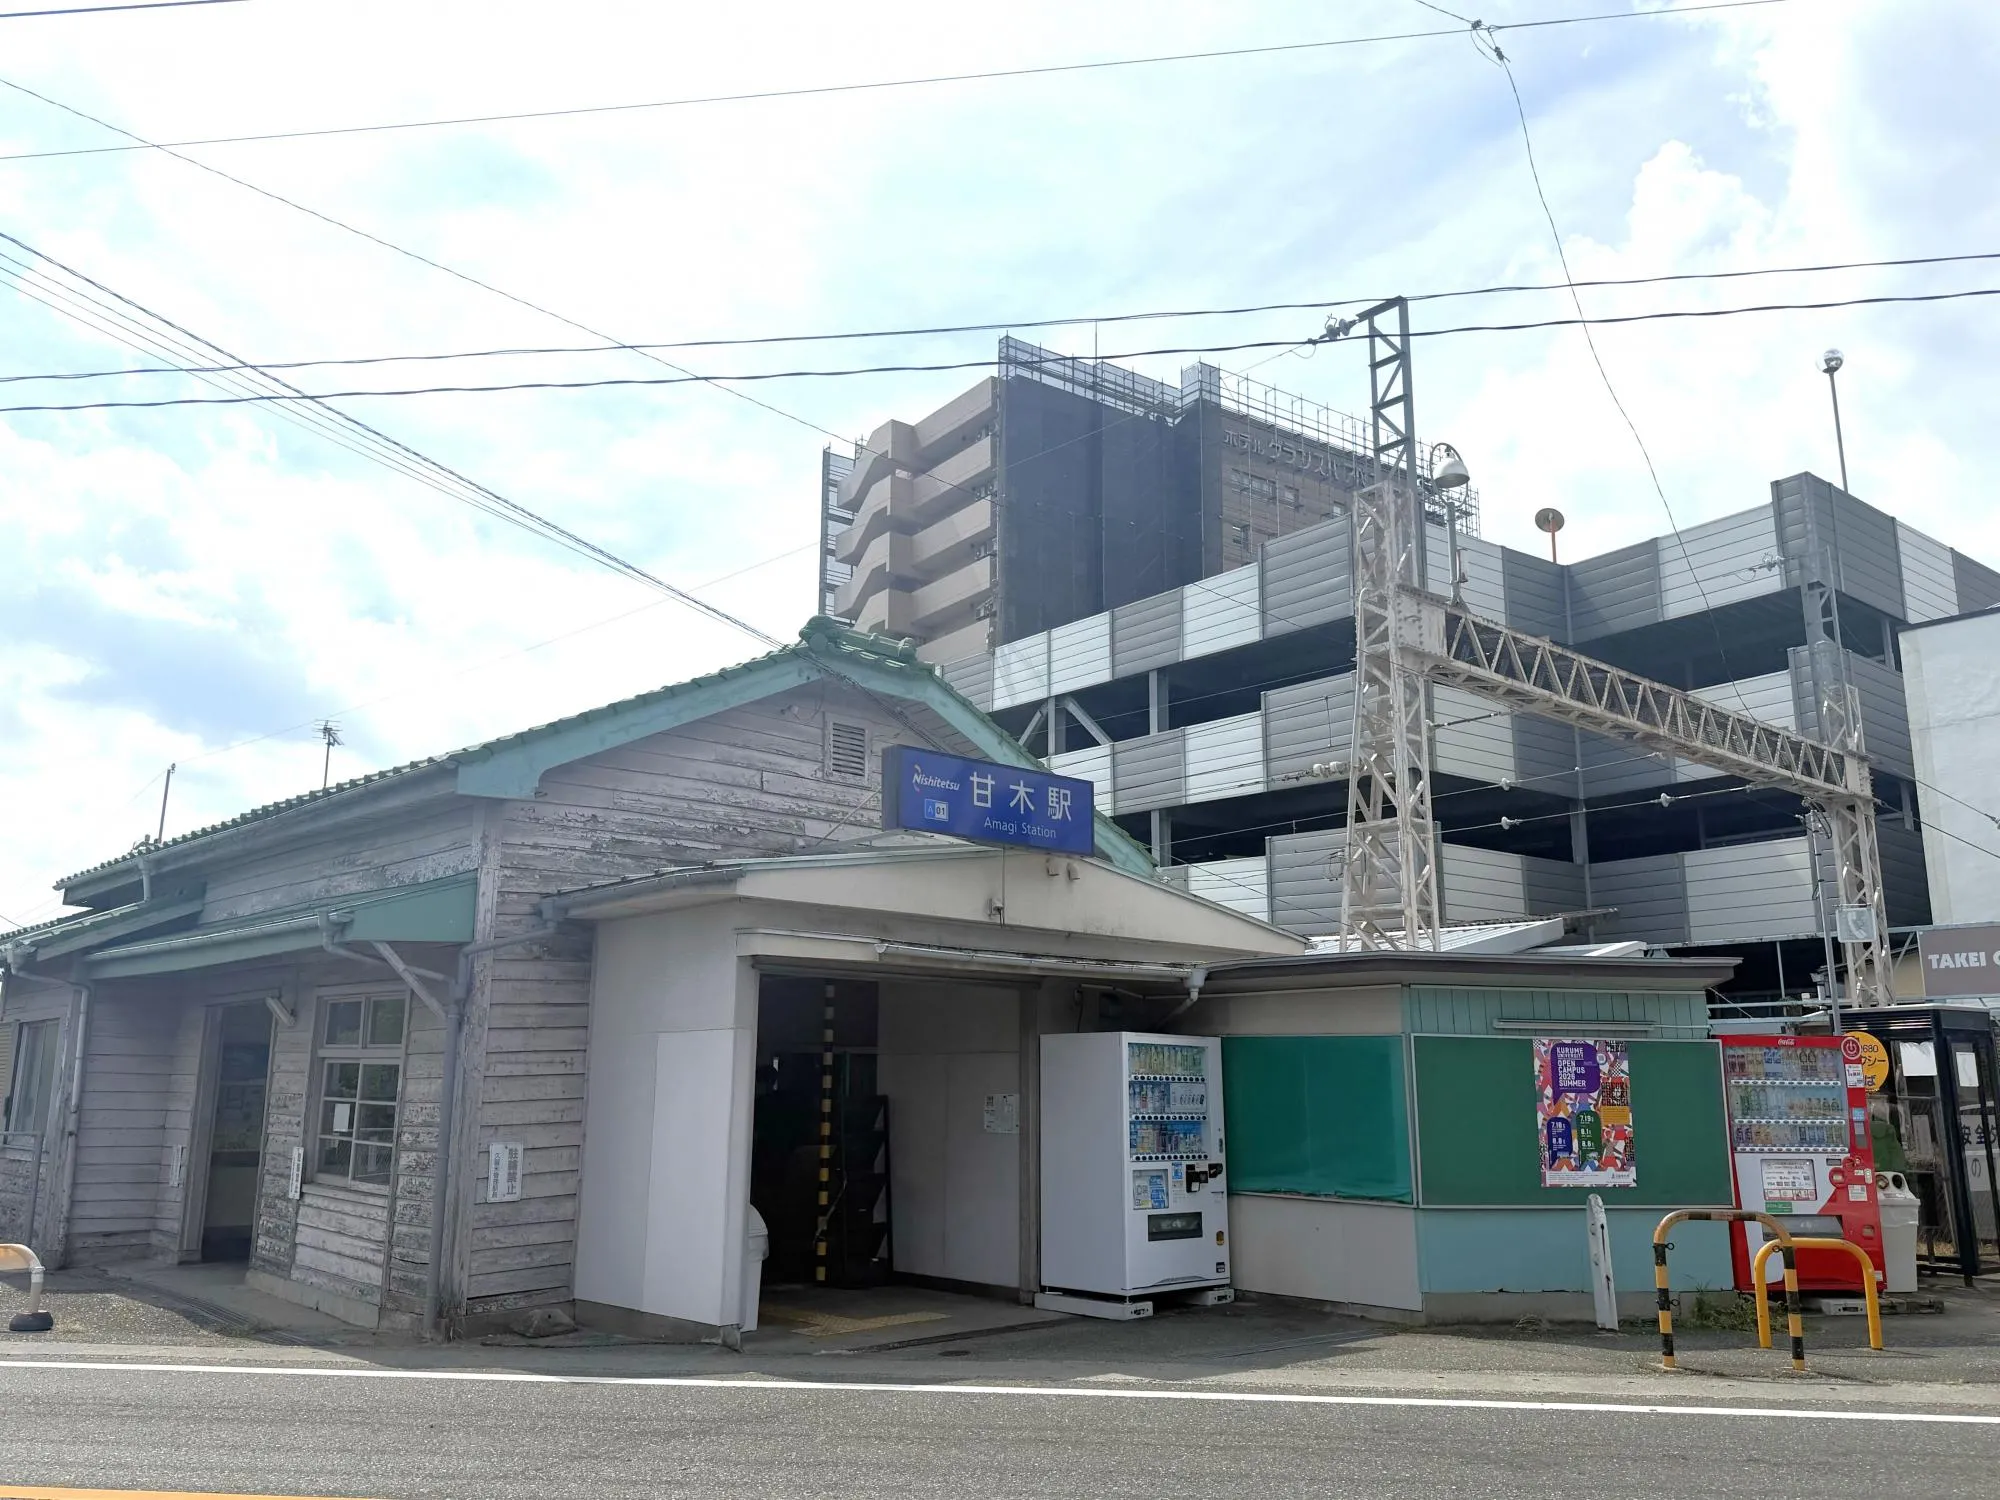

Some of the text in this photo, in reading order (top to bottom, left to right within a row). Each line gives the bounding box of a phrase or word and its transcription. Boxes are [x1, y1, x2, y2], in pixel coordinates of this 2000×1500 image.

[912, 770, 960, 792] Nishitetsu
[969, 771, 1072, 822] 甘木駅
[984, 816, 1057, 839] Amagi Station
[1928, 951, 1987, 969] TAKEI
[1861, 1044, 1879, 1053] 680
[1558, 1066, 1586, 1074] CAMPUS
